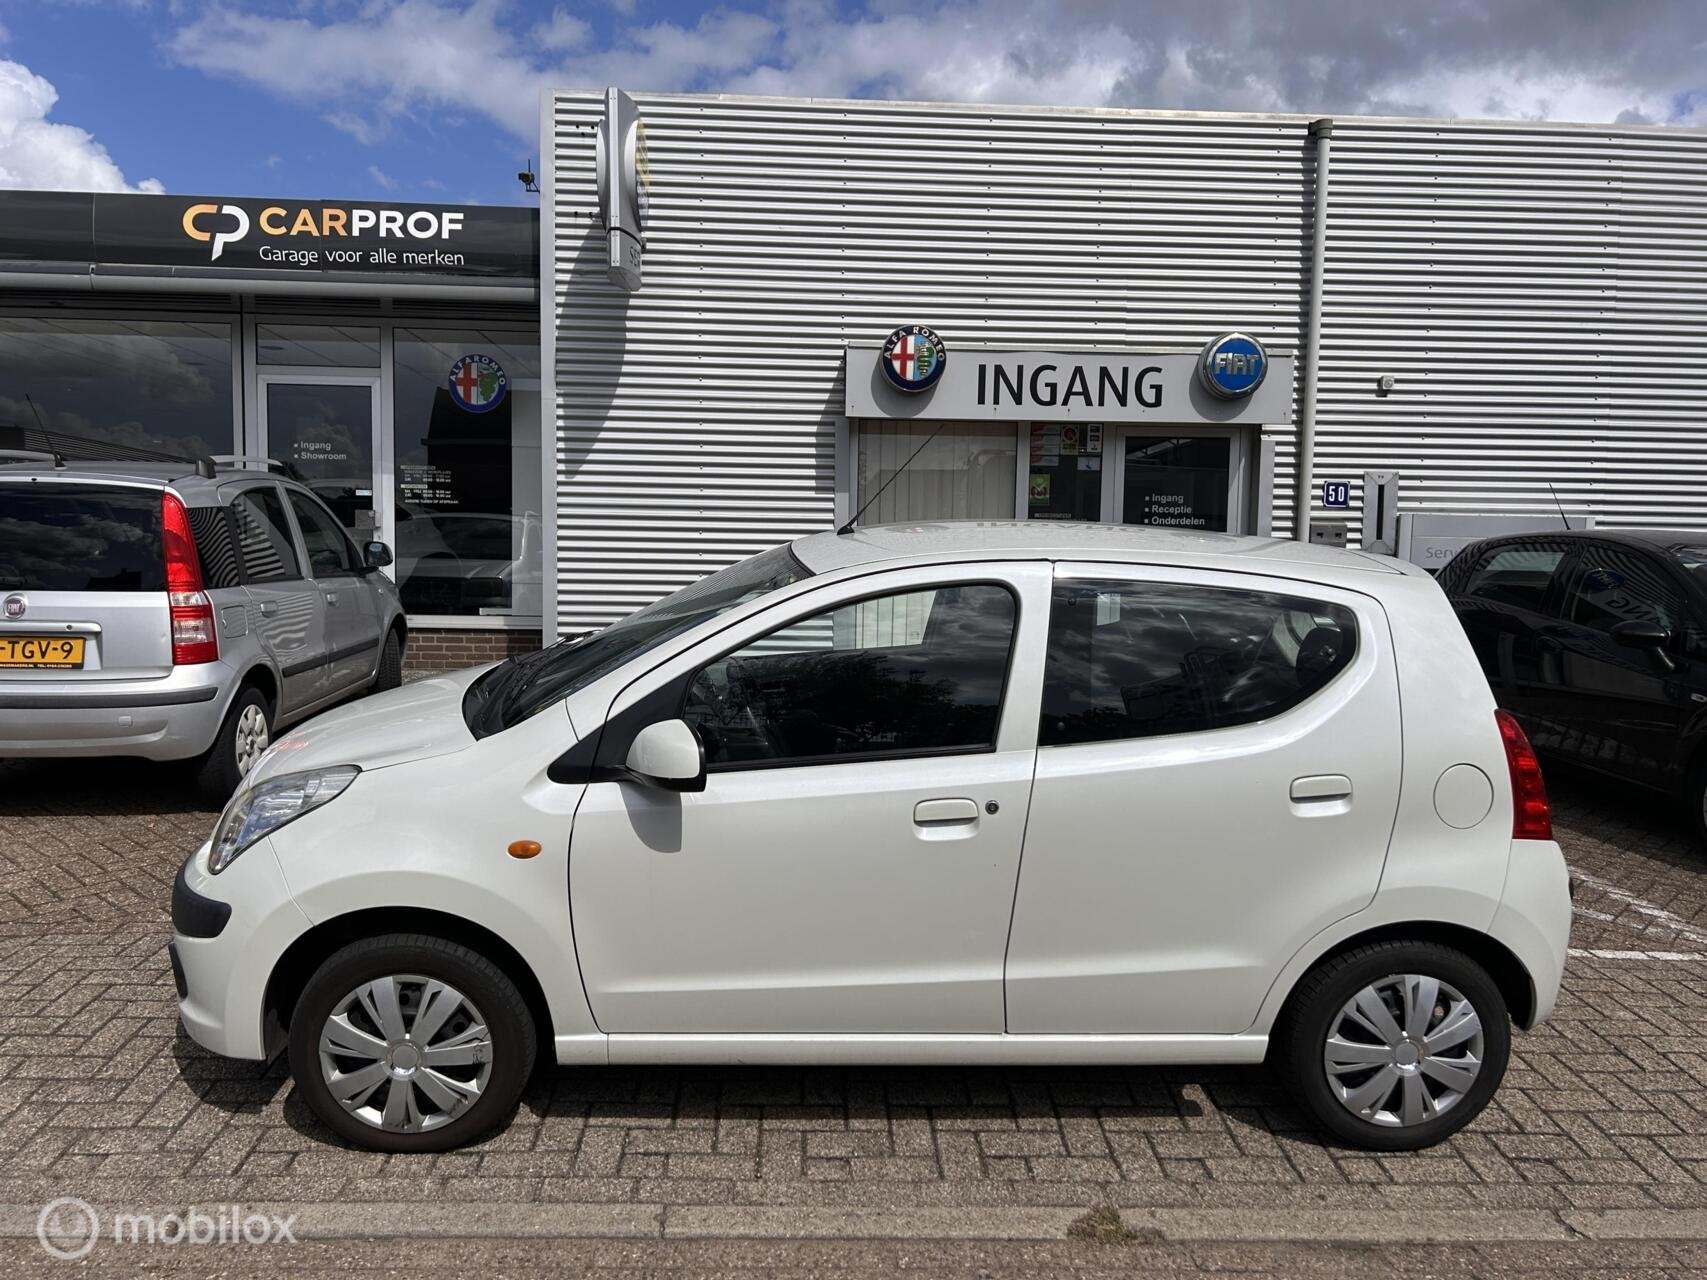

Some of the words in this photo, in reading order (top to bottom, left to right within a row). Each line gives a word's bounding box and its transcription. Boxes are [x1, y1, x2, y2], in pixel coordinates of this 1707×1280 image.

[259, 206, 464, 239] CARPROF
[259, 245, 318, 266] Garage
[325, 249, 362, 263] voor
[369, 247, 397, 264] alle
[403, 249, 464, 266] merken
[884, 330, 907, 359] ALFA
[912, 326, 945, 361] ROMEO
[1214, 352, 1260, 376] FIAT
[976, 363, 1163, 408] INGANG
[300, 440, 332, 451] Ingang
[300, 451, 347, 460] Showroom
[1152, 492, 1184, 504] Ingang
[1328, 485, 1346, 503] 50
[1151, 504, 1192, 515] Receptie
[1151, 516, 1205, 525] Onderdelen
